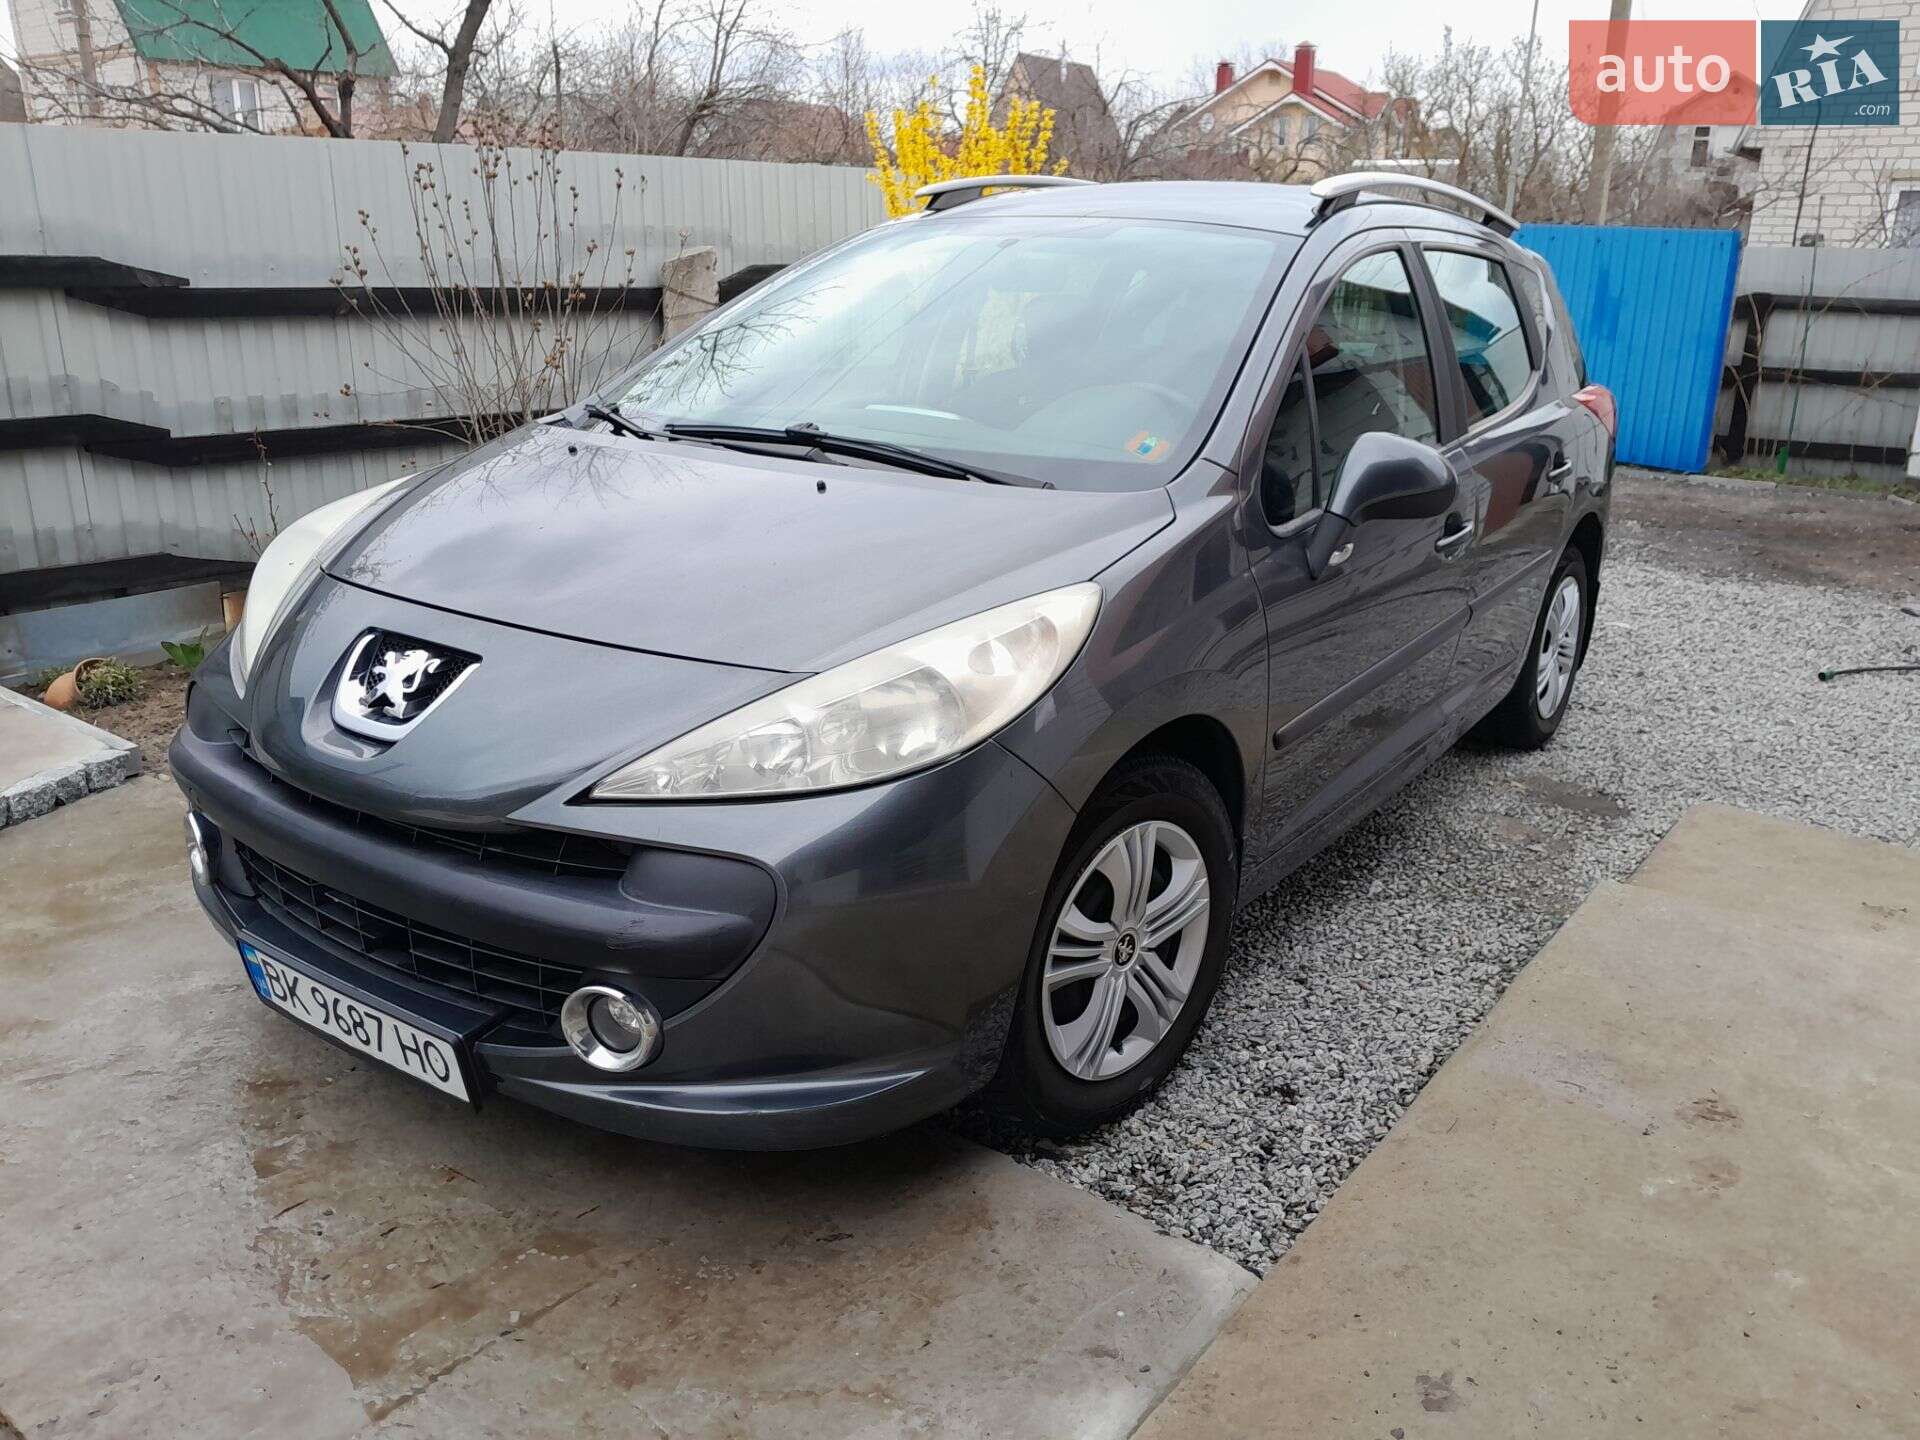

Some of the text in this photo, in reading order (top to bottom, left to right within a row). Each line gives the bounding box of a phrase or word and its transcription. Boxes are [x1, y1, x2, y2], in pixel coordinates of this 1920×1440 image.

[260, 957, 312, 1016] BK
[310, 986, 383, 1052] 9687
[393, 1024, 450, 1083] HO
